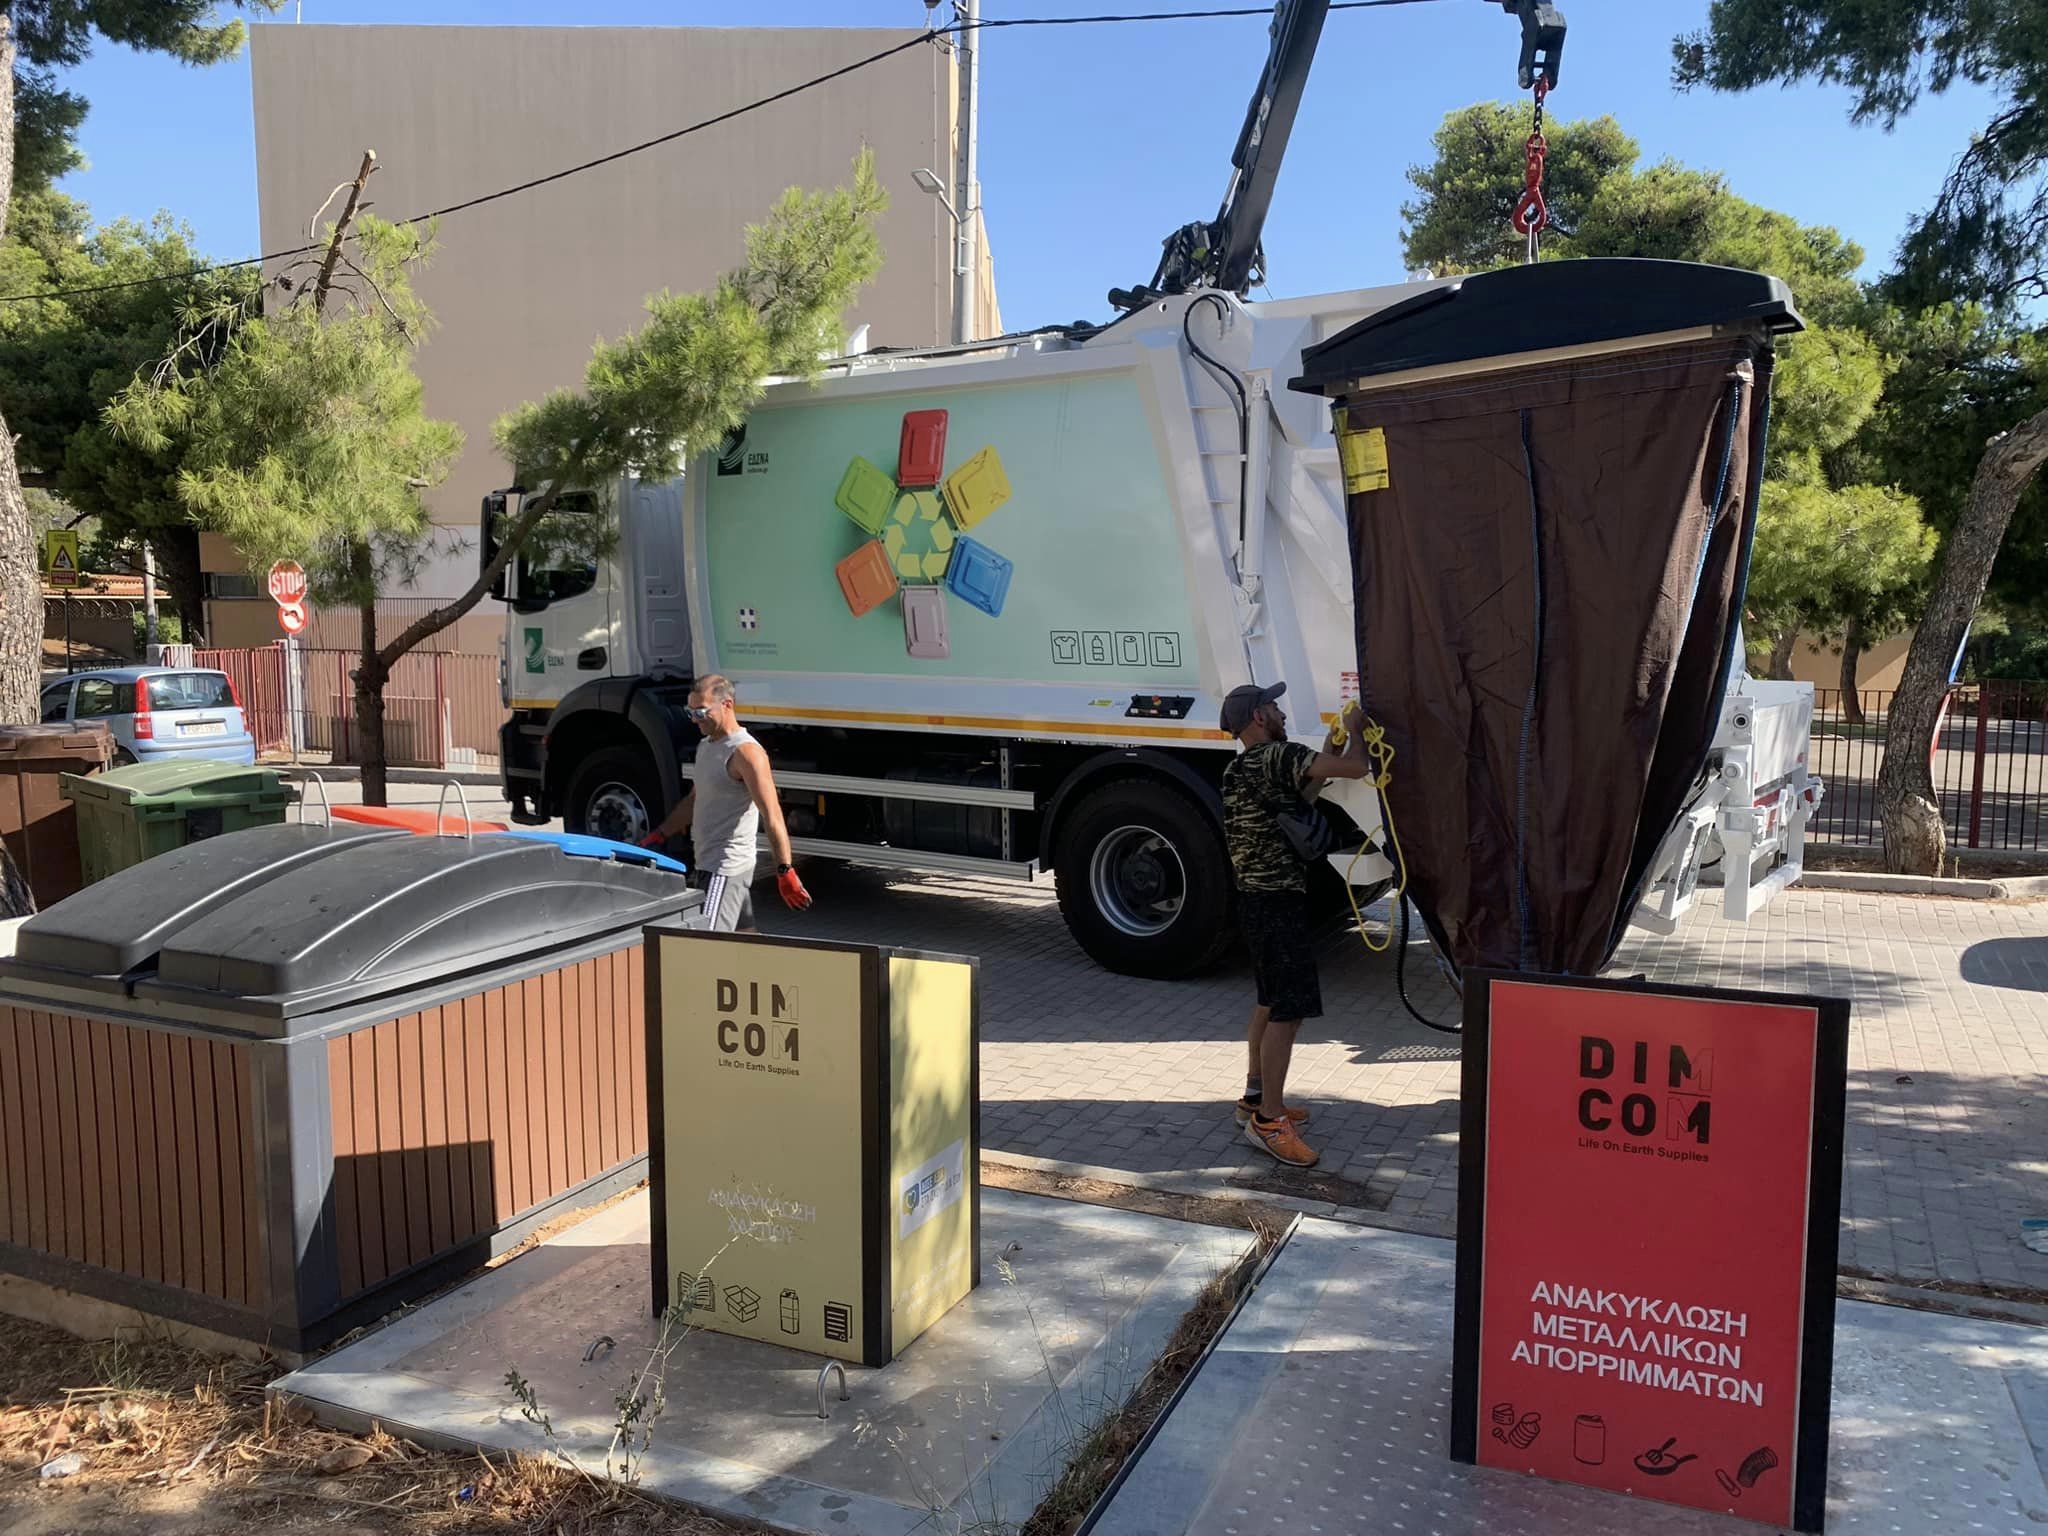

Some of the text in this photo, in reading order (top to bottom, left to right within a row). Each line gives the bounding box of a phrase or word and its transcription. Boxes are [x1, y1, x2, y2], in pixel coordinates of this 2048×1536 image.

[271, 571, 303, 595] STOP
[718, 1058, 800, 1076] Life On Earth Supplies
[1578, 1137, 1709, 1163] Life On Earth Supplies
[1531, 1281, 1747, 1337] ΑΝΑΚΥΚΛΩΣΗ
[1533, 1312, 1741, 1369] ΜΕΤΑΛΛΙΚΩΝ
[1511, 1340, 1763, 1407] ΑΠΟΡΡΙΜΜΑΤΩΝ
